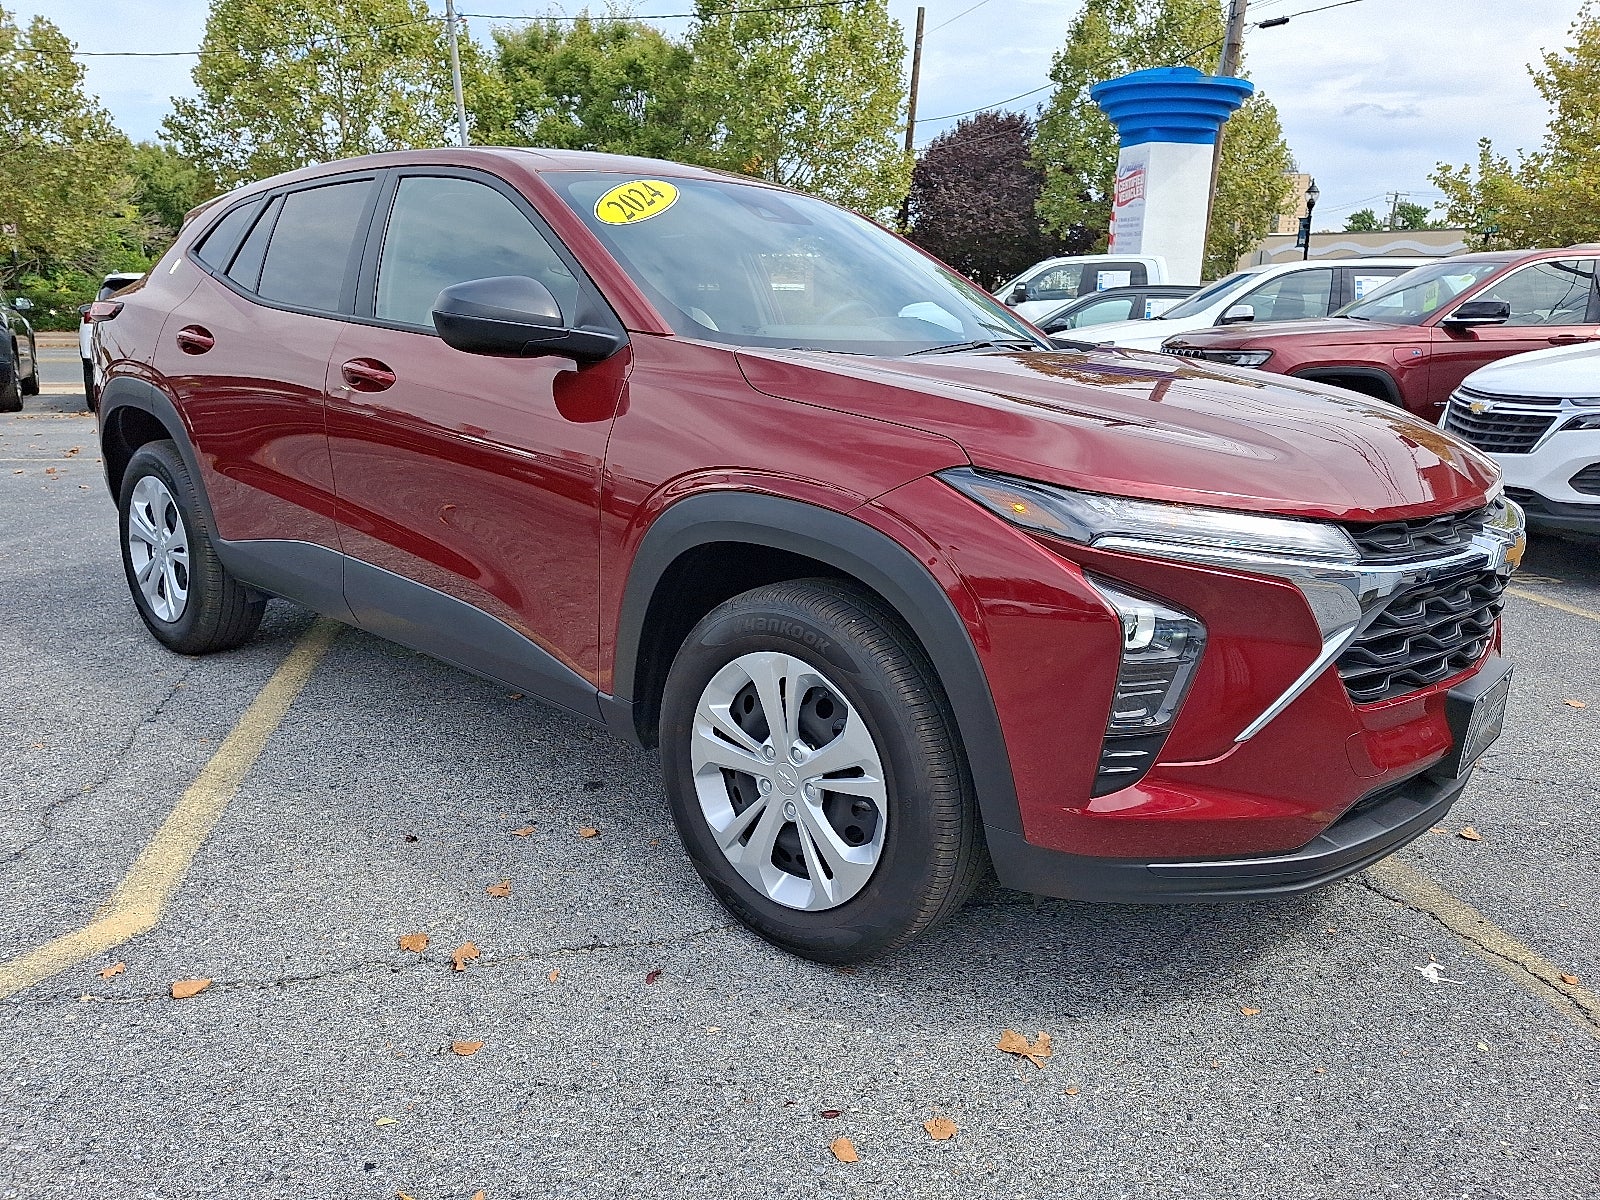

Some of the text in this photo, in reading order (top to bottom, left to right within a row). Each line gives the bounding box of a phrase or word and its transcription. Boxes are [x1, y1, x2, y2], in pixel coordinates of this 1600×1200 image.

[1118, 174, 1144, 192] CERTIFIED
[606, 181, 664, 220] 2024
[1118, 185, 1144, 204] VEHICLES
